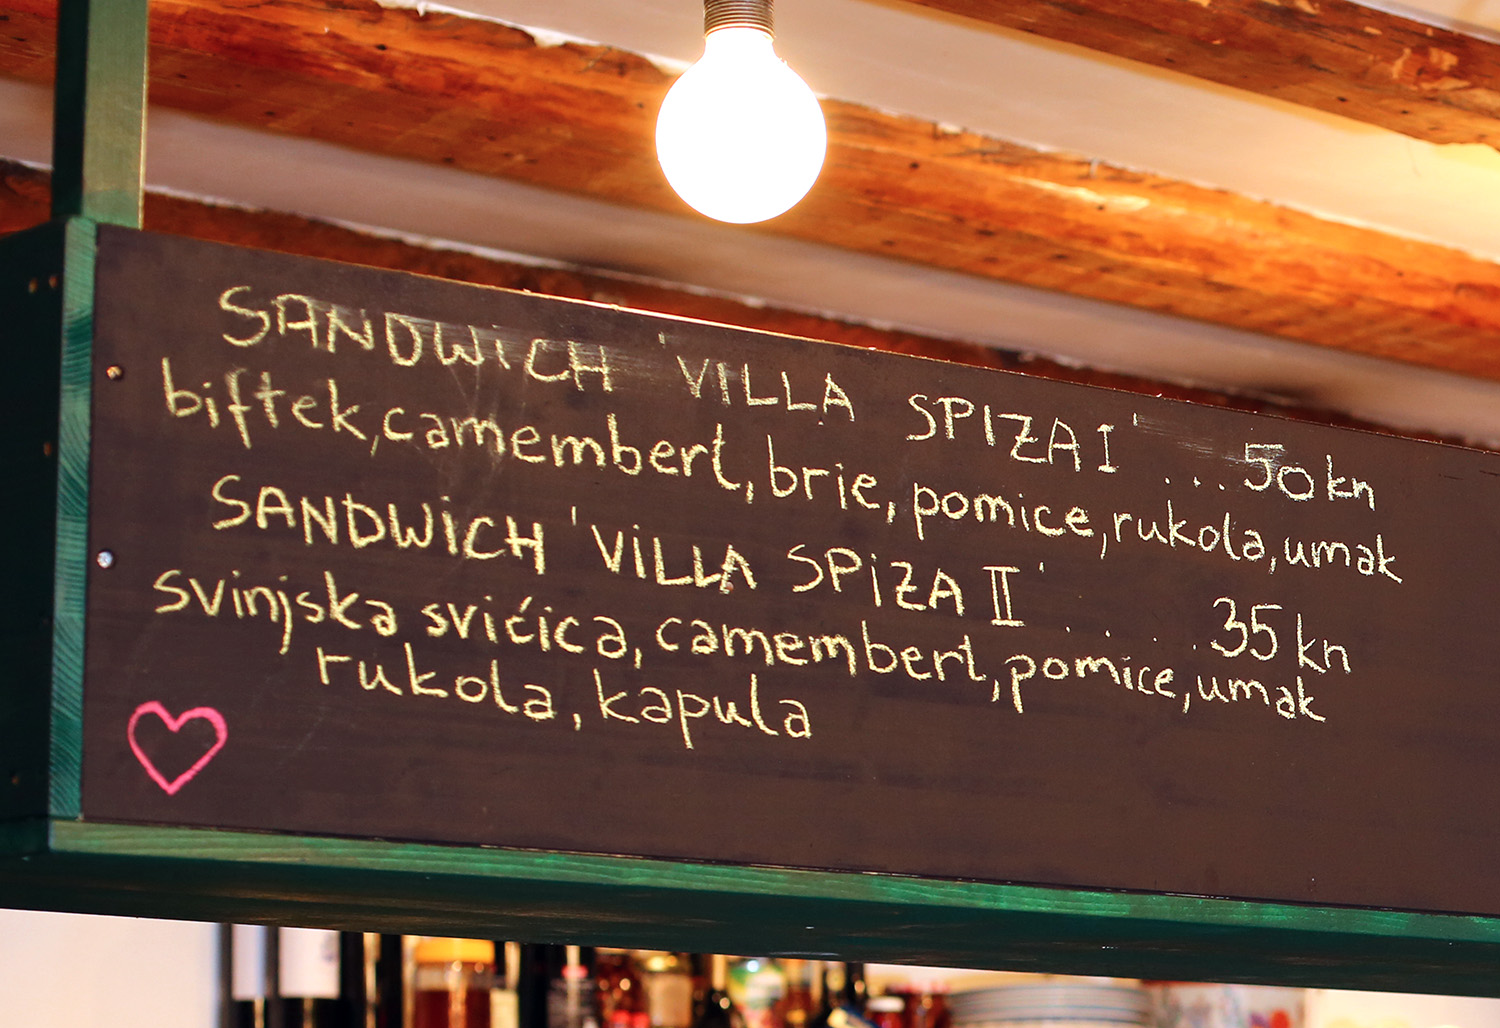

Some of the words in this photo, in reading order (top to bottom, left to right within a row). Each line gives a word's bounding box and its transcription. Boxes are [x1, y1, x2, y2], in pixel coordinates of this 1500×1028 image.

[1210, 596, 1284, 662] 35
[1296, 613, 1352, 675] kn
[592, 668, 812, 750] kapula
[1194, 674, 1328, 724] umak
